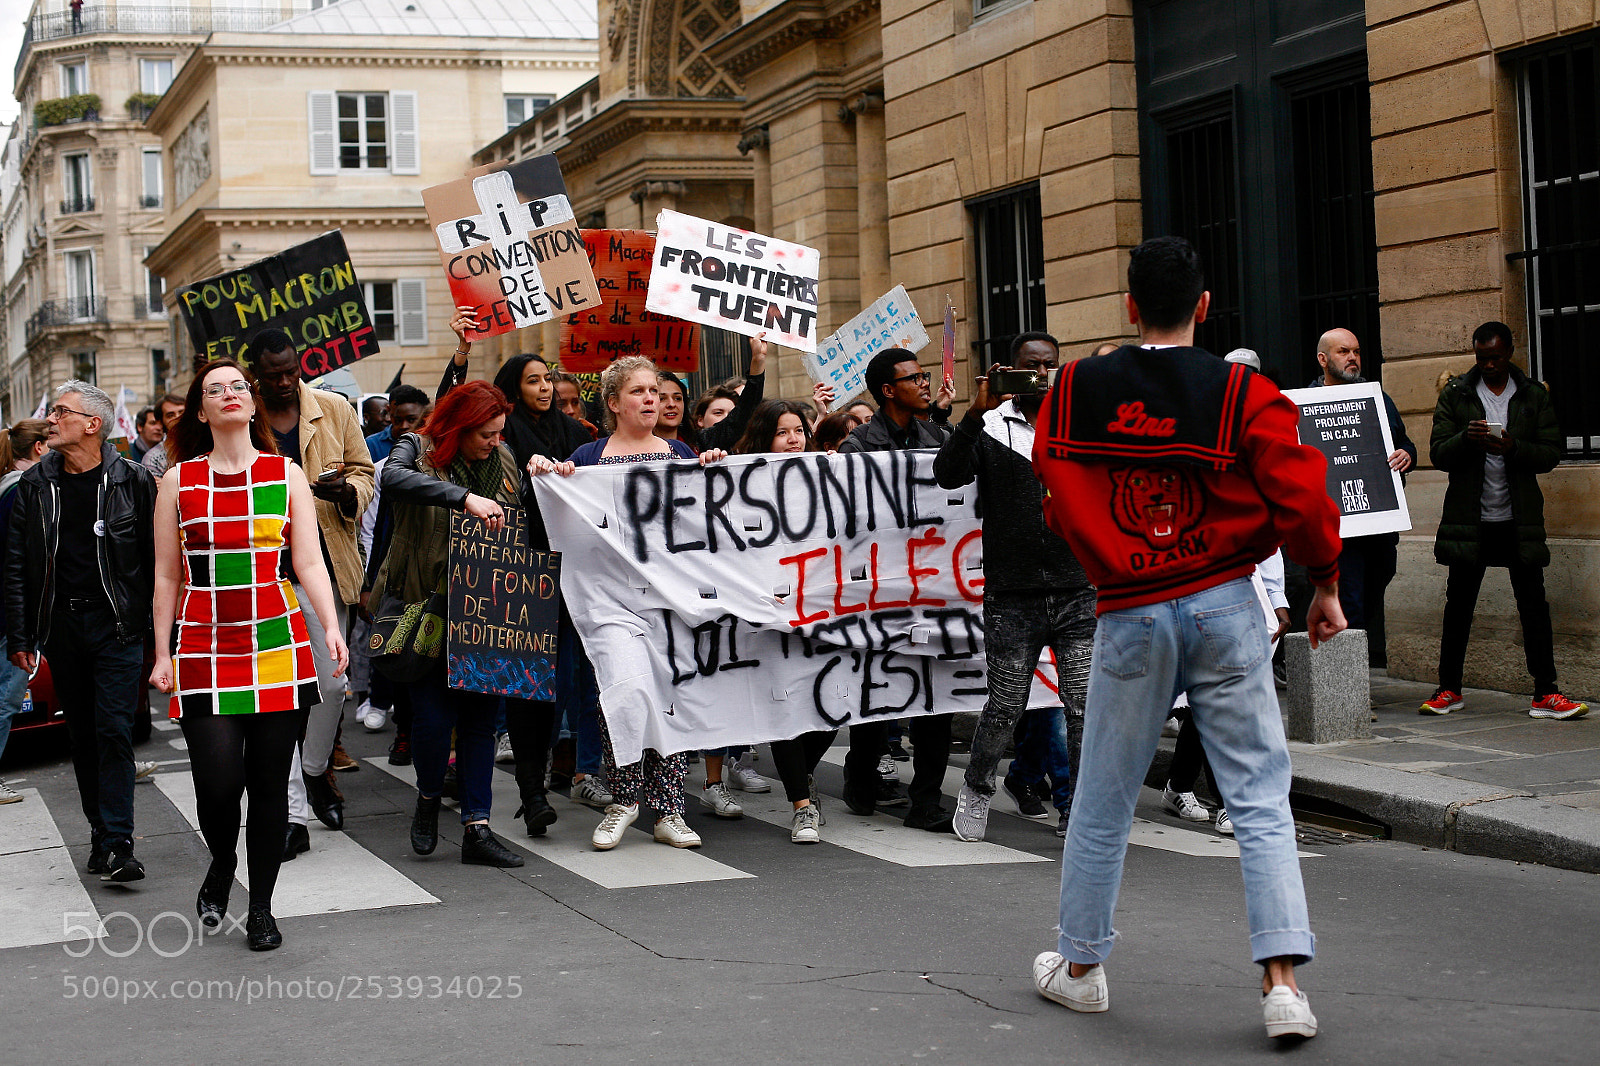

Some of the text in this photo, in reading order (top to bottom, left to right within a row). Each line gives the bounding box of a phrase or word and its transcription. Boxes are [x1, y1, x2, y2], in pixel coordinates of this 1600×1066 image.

[608, 235, 654, 262] Macro
[706, 226, 767, 260] LES
[182, 273, 256, 318] POUR
[235, 261, 355, 329] MACRON
[498, 270, 539, 297] DE
[473, 279, 588, 333] GENEVE
[609, 299, 631, 325] dit
[691, 284, 818, 339] TUENT
[206, 301, 364, 368] ET CLOMB
[1302, 400, 1368, 417] ENFERMEMENT
[1314, 412, 1362, 429] PROLONGÉ
[1320, 428, 1361, 442] EN C.R.A.
[1333, 454, 1359, 466] MORT
[1340, 478, 1365, 497] ACT UP
[1343, 494, 1370, 512] PARIS
[623, 450, 944, 564] PERSONNE
[1129, 530, 1209, 571] OZARK
[451, 562, 555, 600] AU FOND
[779, 526, 985, 627] ILLÉG
[464, 595, 530, 627] DE LA
[662, 608, 760, 686] LOI
[813, 650, 934, 727] C'EST
[22, 702, 31, 711] 57
